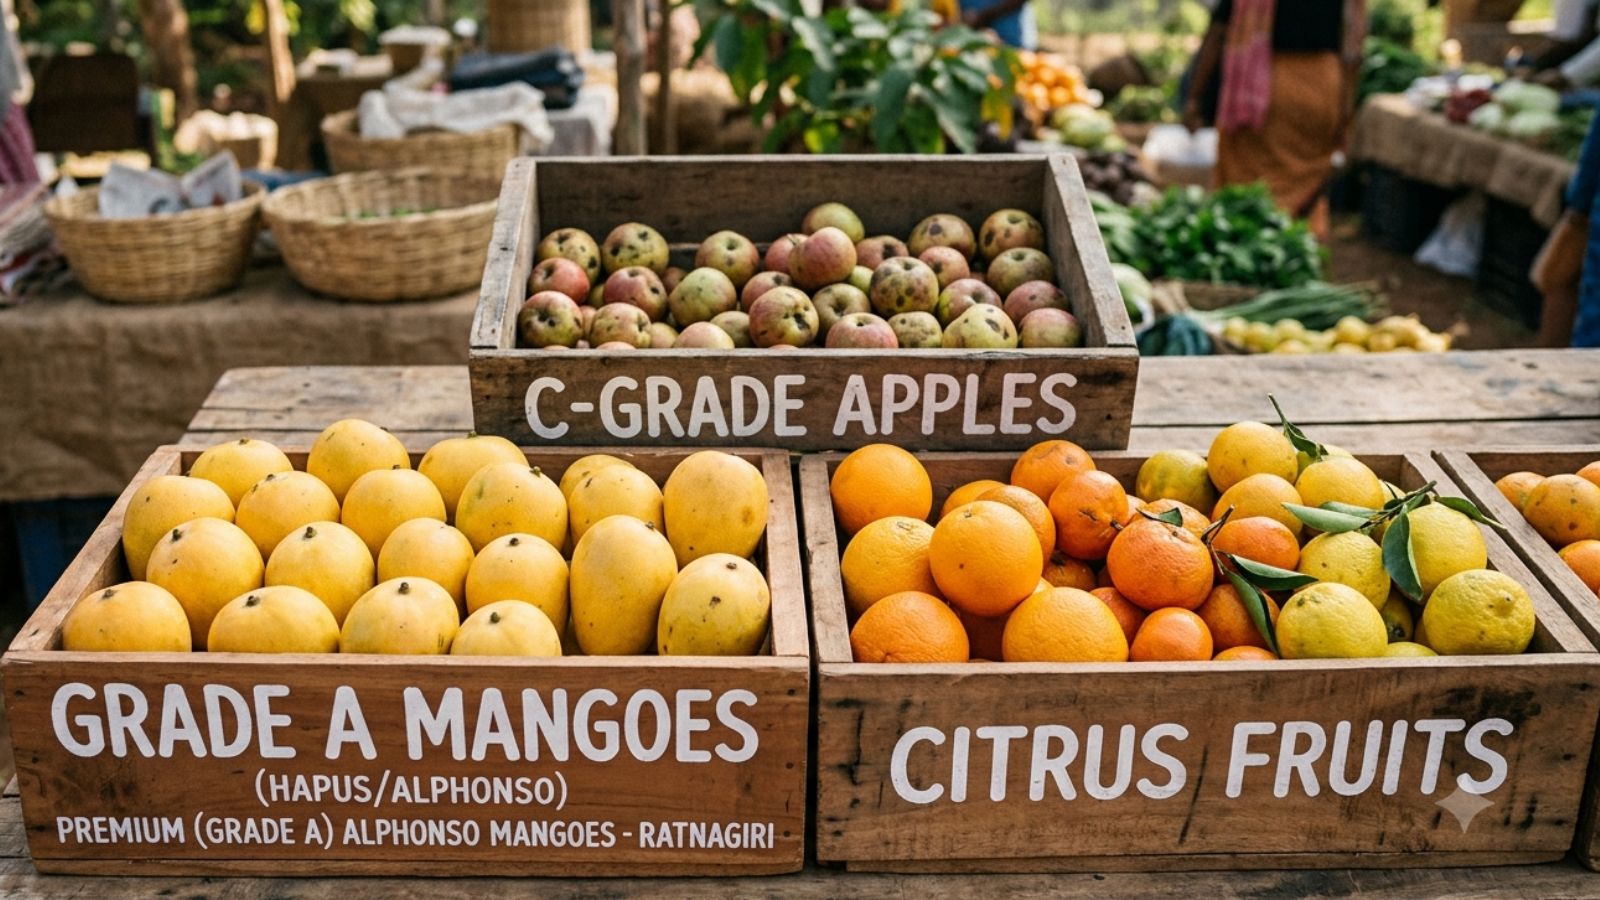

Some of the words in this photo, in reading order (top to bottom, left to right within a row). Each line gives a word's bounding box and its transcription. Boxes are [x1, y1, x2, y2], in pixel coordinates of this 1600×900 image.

[524, 375, 806, 438] C-GRADE
[833, 373, 1076, 435] APPLES
[52, 683, 296, 758] GRADE
[325, 686, 377, 760] A
[404, 687, 758, 762] MANGOES
[255, 768, 568, 810] (HAPUS/ALPHONSO)
[891, 724, 1188, 803] CITRUS
[1226, 719, 1514, 798] FRUITS
[56, 817, 185, 844] PREMIUM
[194, 812, 295, 849] (GRADE
[304, 813, 333, 849] A)
[343, 818, 480, 845] ALPHONSO
[491, 820, 615, 847] MANGOES
[639, 822, 773, 849] RATNAGIRI
